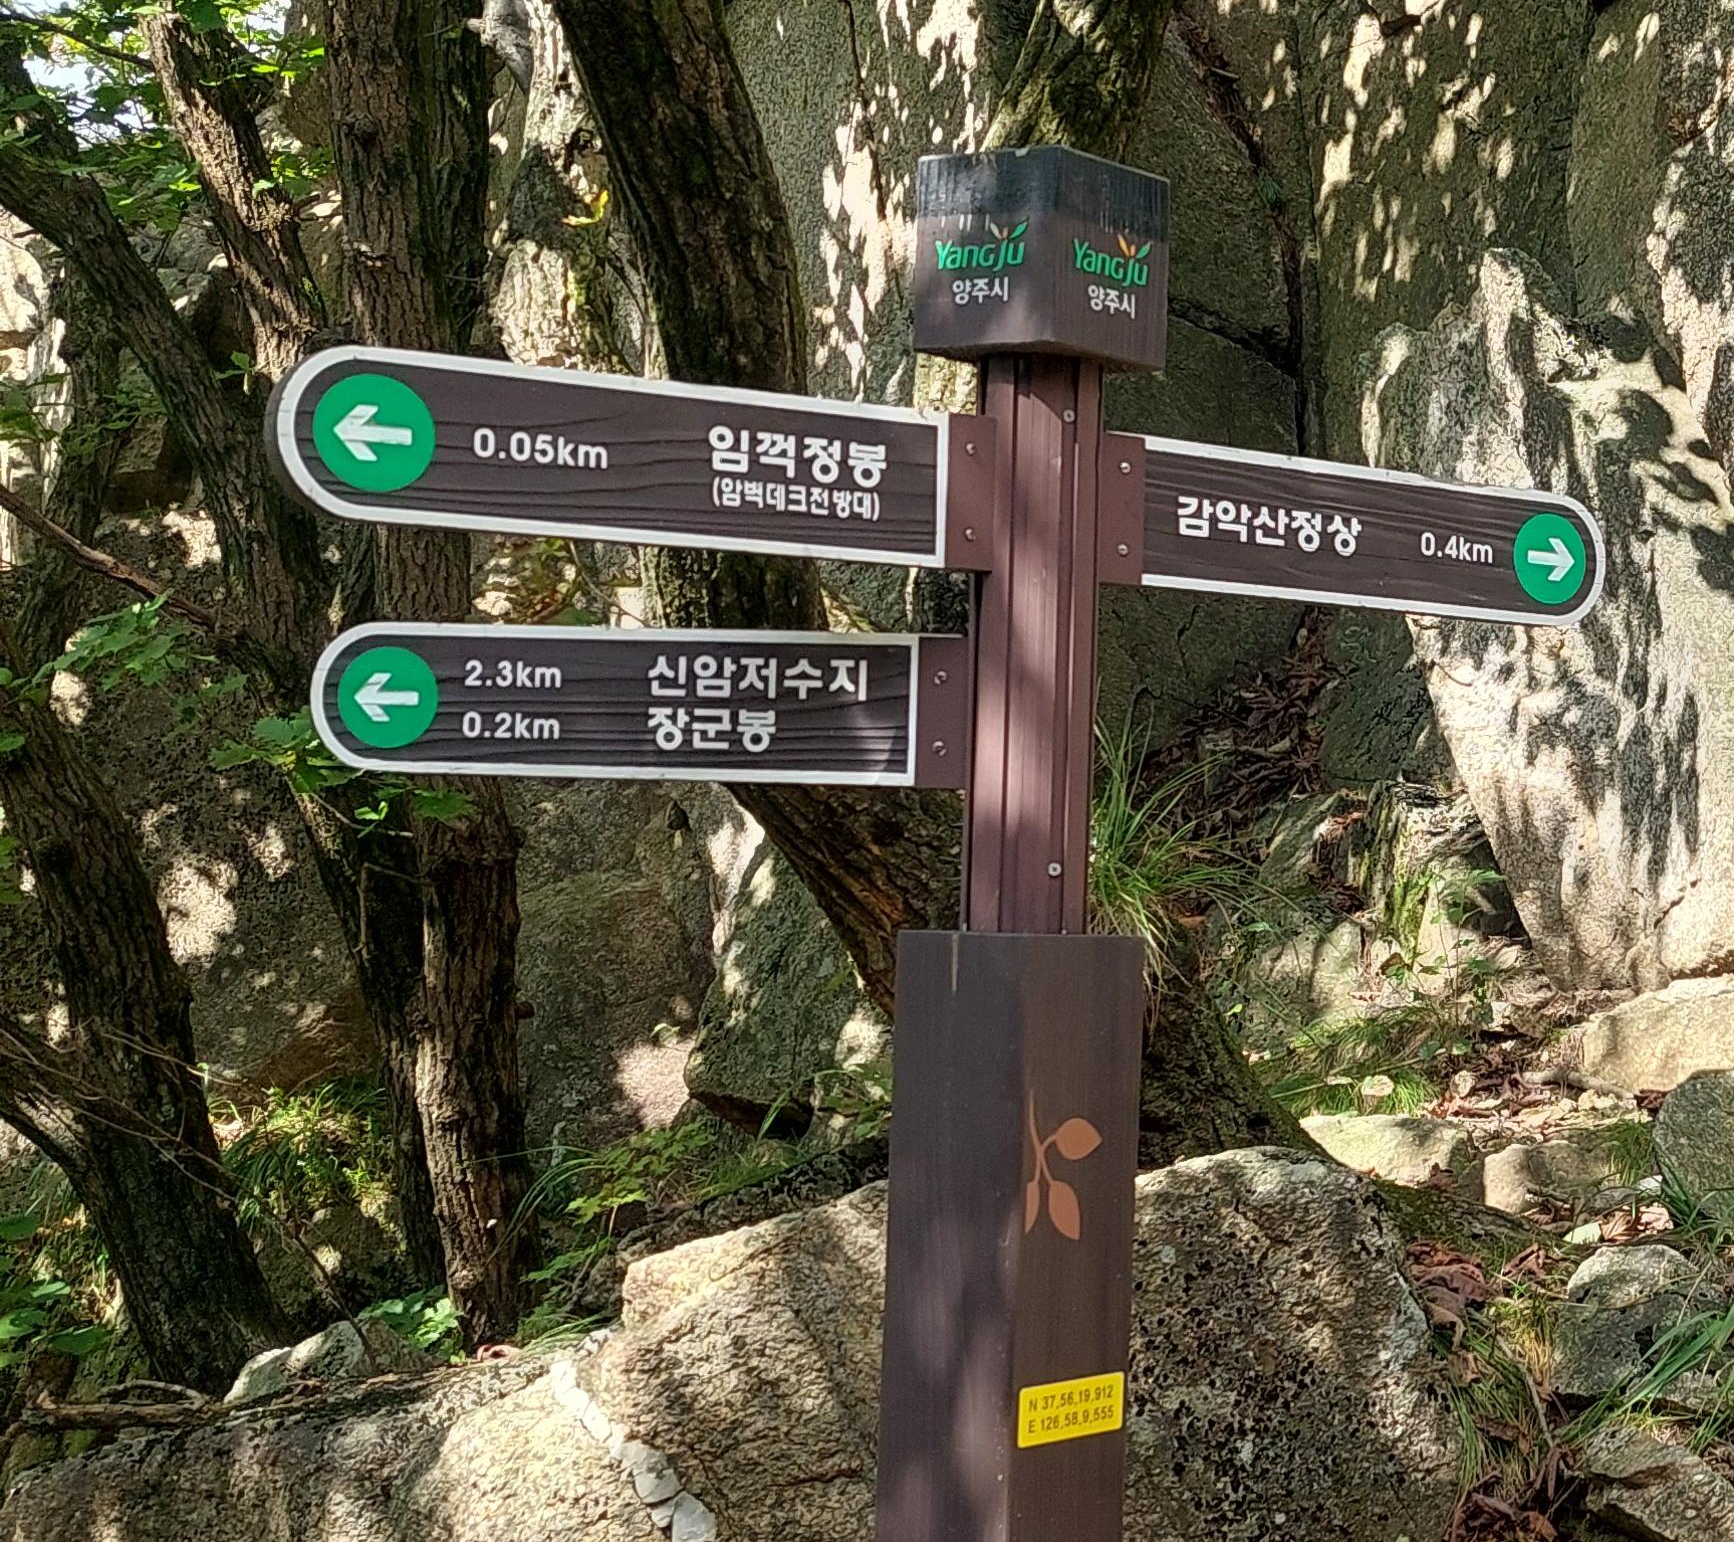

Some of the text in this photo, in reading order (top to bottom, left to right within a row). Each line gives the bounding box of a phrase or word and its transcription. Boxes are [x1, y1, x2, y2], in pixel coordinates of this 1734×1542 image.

[952, 276, 1010, 305] 양주시
[1087, 284, 1137, 319] 양주시
[472, 424, 888, 489] 0.05km 임꺽정봉
[1176, 494, 1494, 565] 감악산정상 0.4km
[463, 654, 868, 703] 2.3km 신암저수지
[461, 706, 777, 754] 0.2km 장군봉
[1028, 1398, 1038, 1412] N
[1028, 1418, 1036, 1434] E
